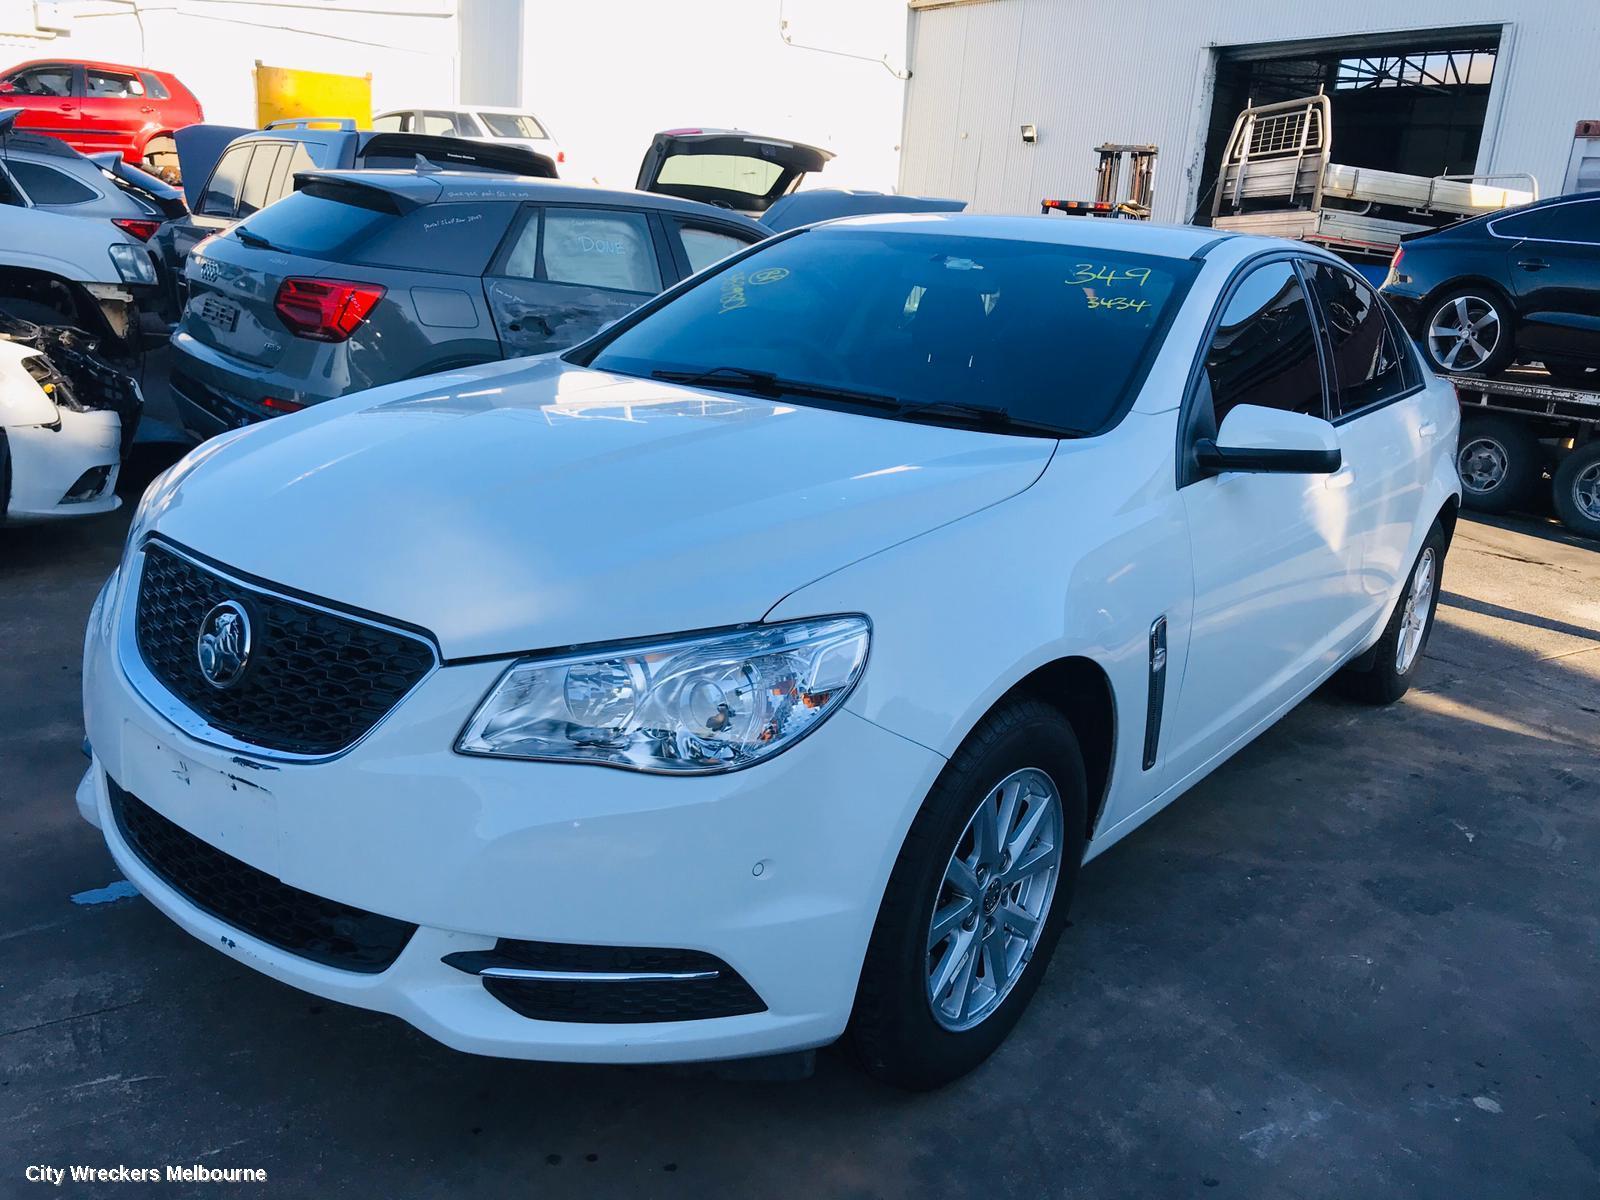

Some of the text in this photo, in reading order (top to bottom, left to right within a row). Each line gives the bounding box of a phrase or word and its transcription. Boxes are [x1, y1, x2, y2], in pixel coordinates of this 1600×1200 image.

[579, 235, 626, 256] DONE
[1064, 263, 1152, 287] 349
[1086, 296, 1152, 313] 3434
